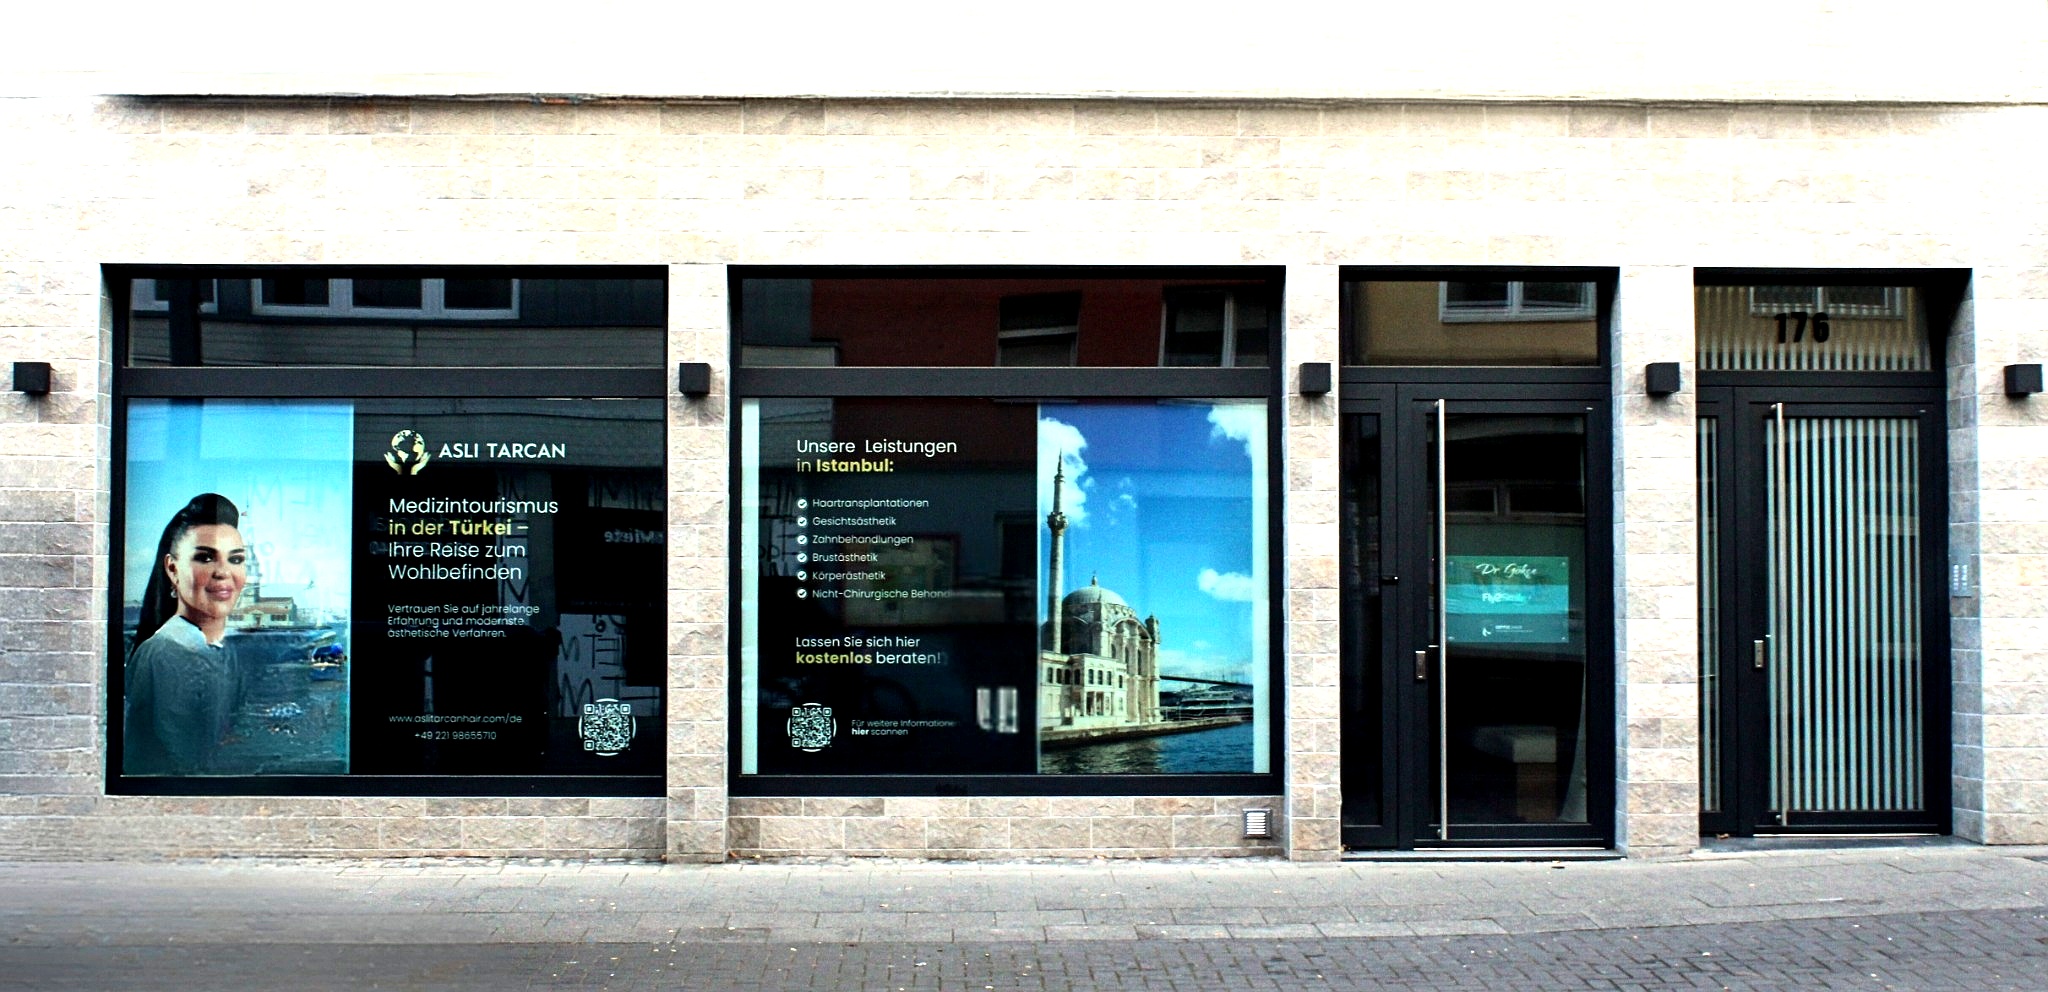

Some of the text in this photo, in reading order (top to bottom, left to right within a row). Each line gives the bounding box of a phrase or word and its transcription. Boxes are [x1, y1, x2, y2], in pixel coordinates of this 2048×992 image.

[1775, 311, 1830, 344] 176
[439, 443, 565, 458] ASLI TARCAN
[797, 439, 957, 457] Unsere Leistungen
[797, 458, 893, 472] in Istanbul:
[390, 497, 558, 513] Medizintourismus
[813, 499, 928, 509] Haartransplantationen
[390, 519, 405, 534] in
[412, 520, 444, 535] der
[449, 519, 511, 535] Türkei
[813, 516, 897, 526] Gesichtsästhetik
[813, 535, 913, 546] Zahnbehandlungen
[390, 542, 424, 557] Ihre
[431, 542, 479, 557] Reise
[485, 545, 525, 557] zum
[813, 552, 879, 562] Brustästhetik
[389, 564, 521, 580] Wohlbefinden
[1475, 563, 1501, 575] Dr
[813, 571, 885, 581] Körperästhetik
[813, 589, 908, 600] Nicht-Chirurgische
[388, 603, 539, 617] Vertrauen Sie auf jahrelange
[388, 616, 526, 628] Erfahrung und modernste
[388, 628, 507, 639] ästhetische Verfahren.
[796, 636, 920, 648] Lassen Sie sich hier
[797, 651, 941, 664] kostenlos beraten!
[388, 713, 523, 724] www.aslitarcanhair.com/de
[851, 719, 865, 728] Für
[866, 719, 899, 728] weitere
[415, 730, 433, 740] +49
[436, 730, 450, 740] 221
[870, 728, 909, 736] scannen
